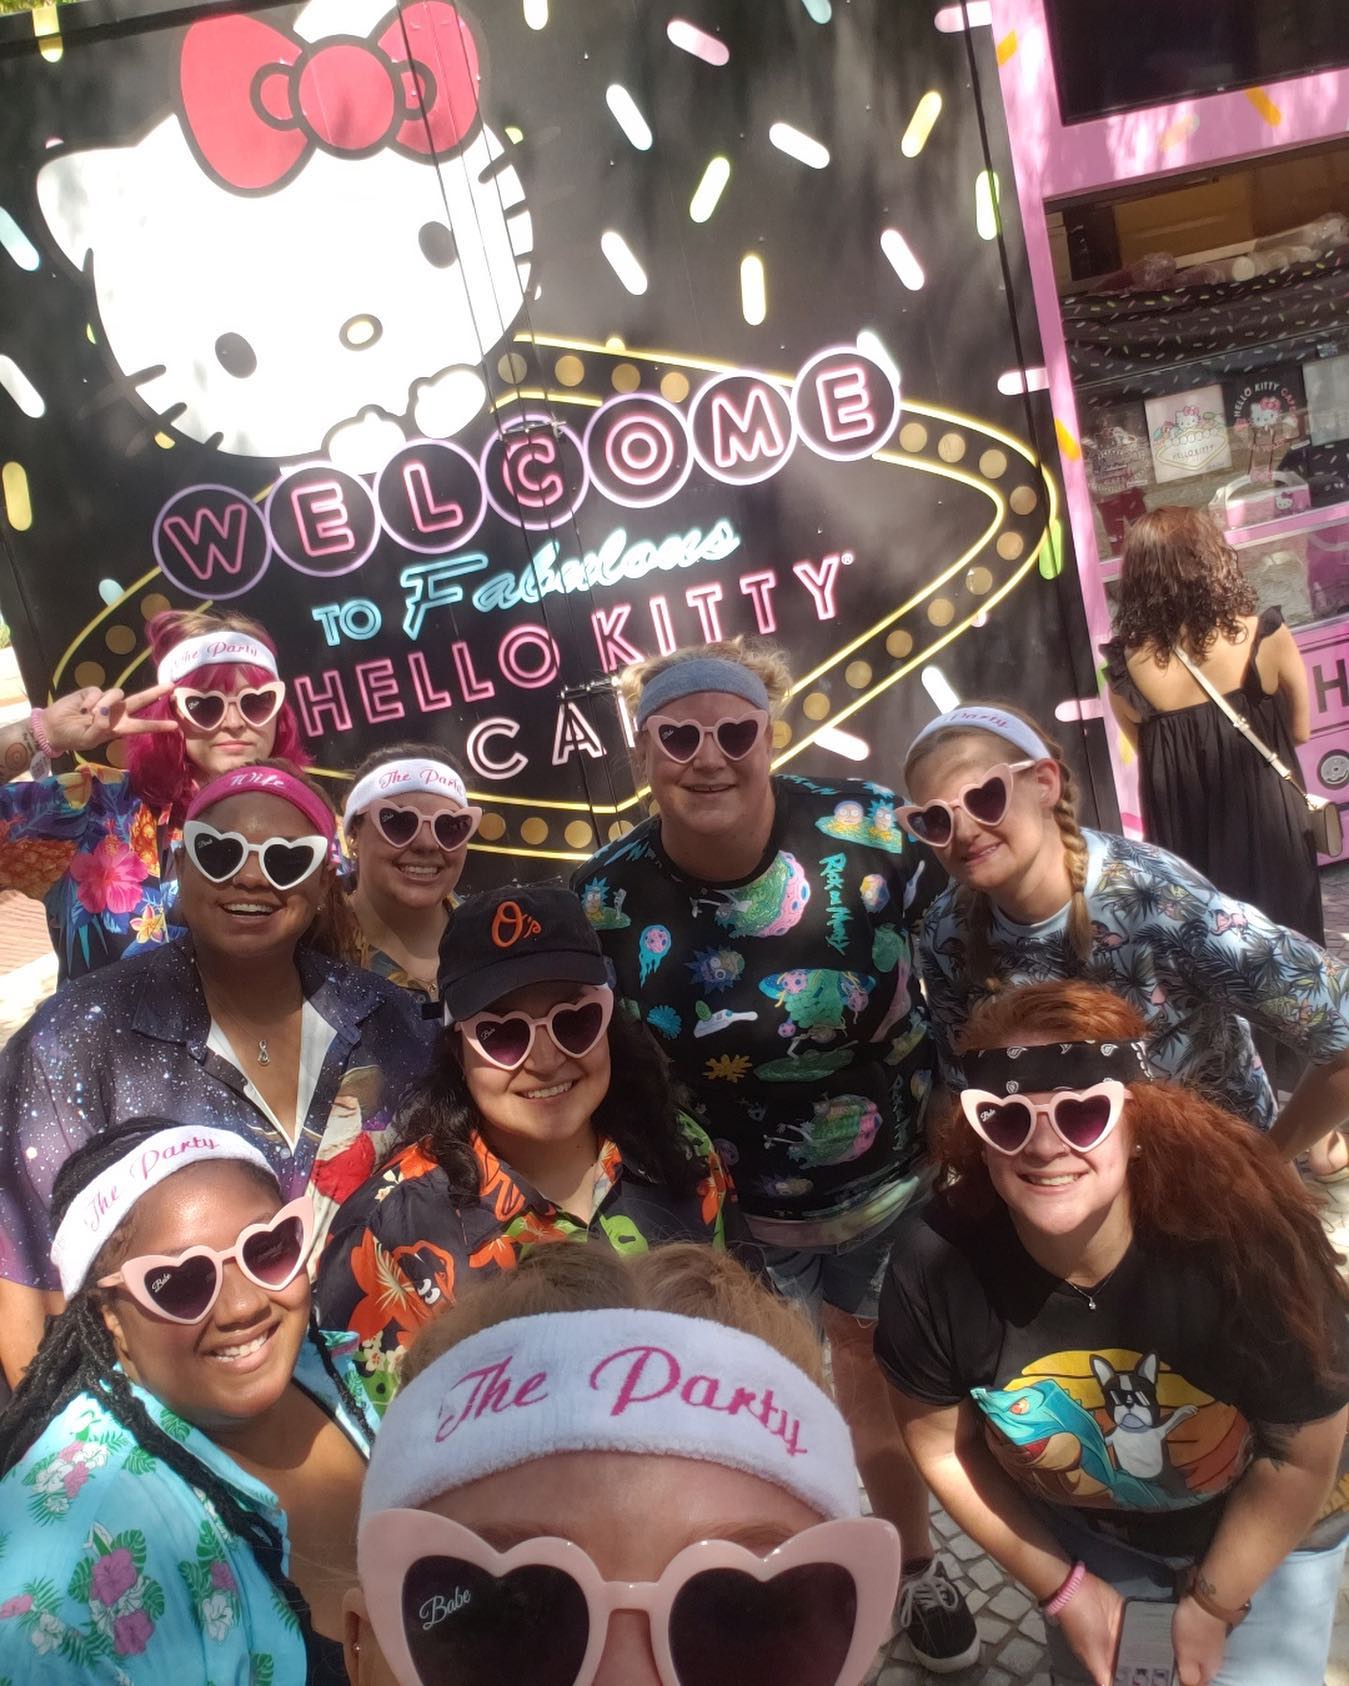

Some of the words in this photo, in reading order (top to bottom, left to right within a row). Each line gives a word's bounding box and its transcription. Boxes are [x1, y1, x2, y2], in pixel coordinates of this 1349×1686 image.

[1233, 387, 1253, 417] HELLO
[1254, 381, 1281, 392] KITTY
[161, 364, 876, 581] WELCOME
[311, 599, 384, 647] TO
[399, 516, 741, 642] Fabulous
[294, 623, 561, 738] HELLO
[229, 771, 287, 789] Wife
[379, 768, 411, 790] The
[490, 900, 542, 948] O's
[83, 1184, 118, 1233] The
[129, 1134, 220, 1181] Party
[434, 1354, 550, 1444] The
[589, 1345, 808, 1458] Party
[418, 1585, 472, 1631] Babe
